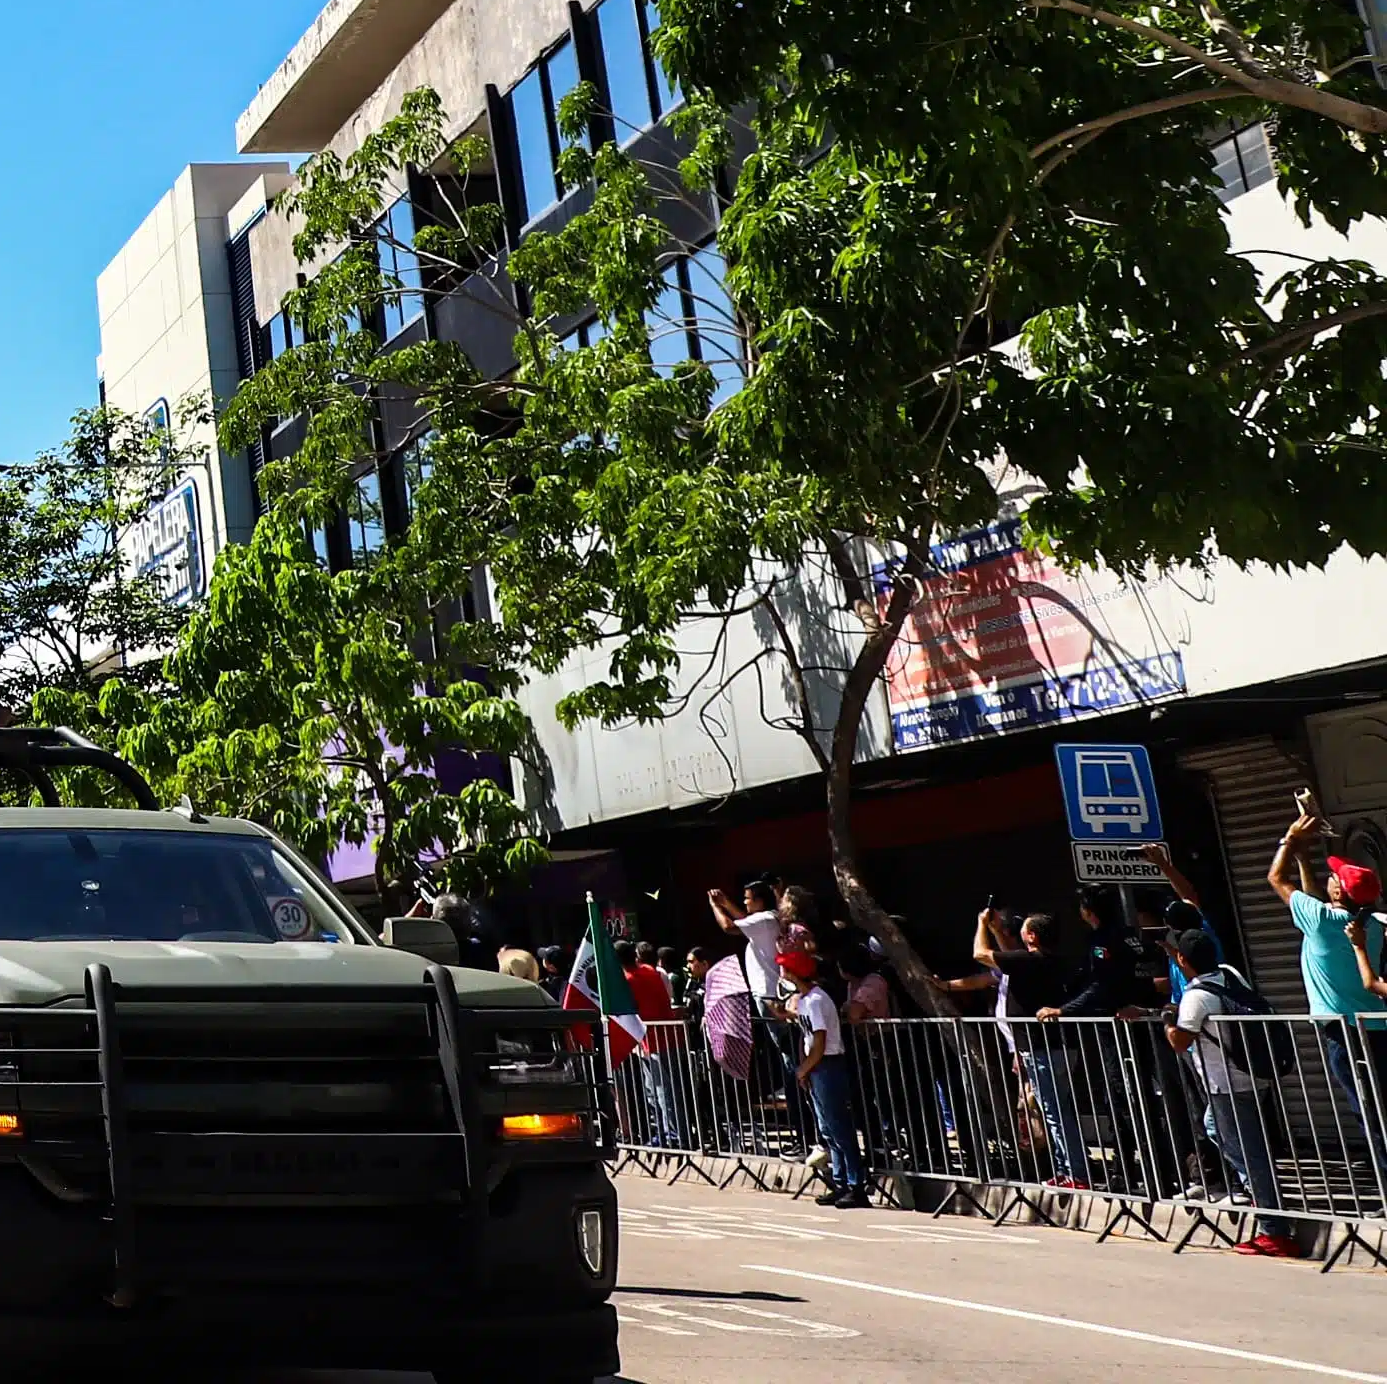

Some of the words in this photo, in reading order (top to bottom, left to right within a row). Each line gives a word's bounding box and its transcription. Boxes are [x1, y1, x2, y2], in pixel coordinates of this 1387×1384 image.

[1082, 849, 1139, 862] PRINC
[1087, 864, 1162, 876] PARADERO
[280, 905, 301, 923] 30
